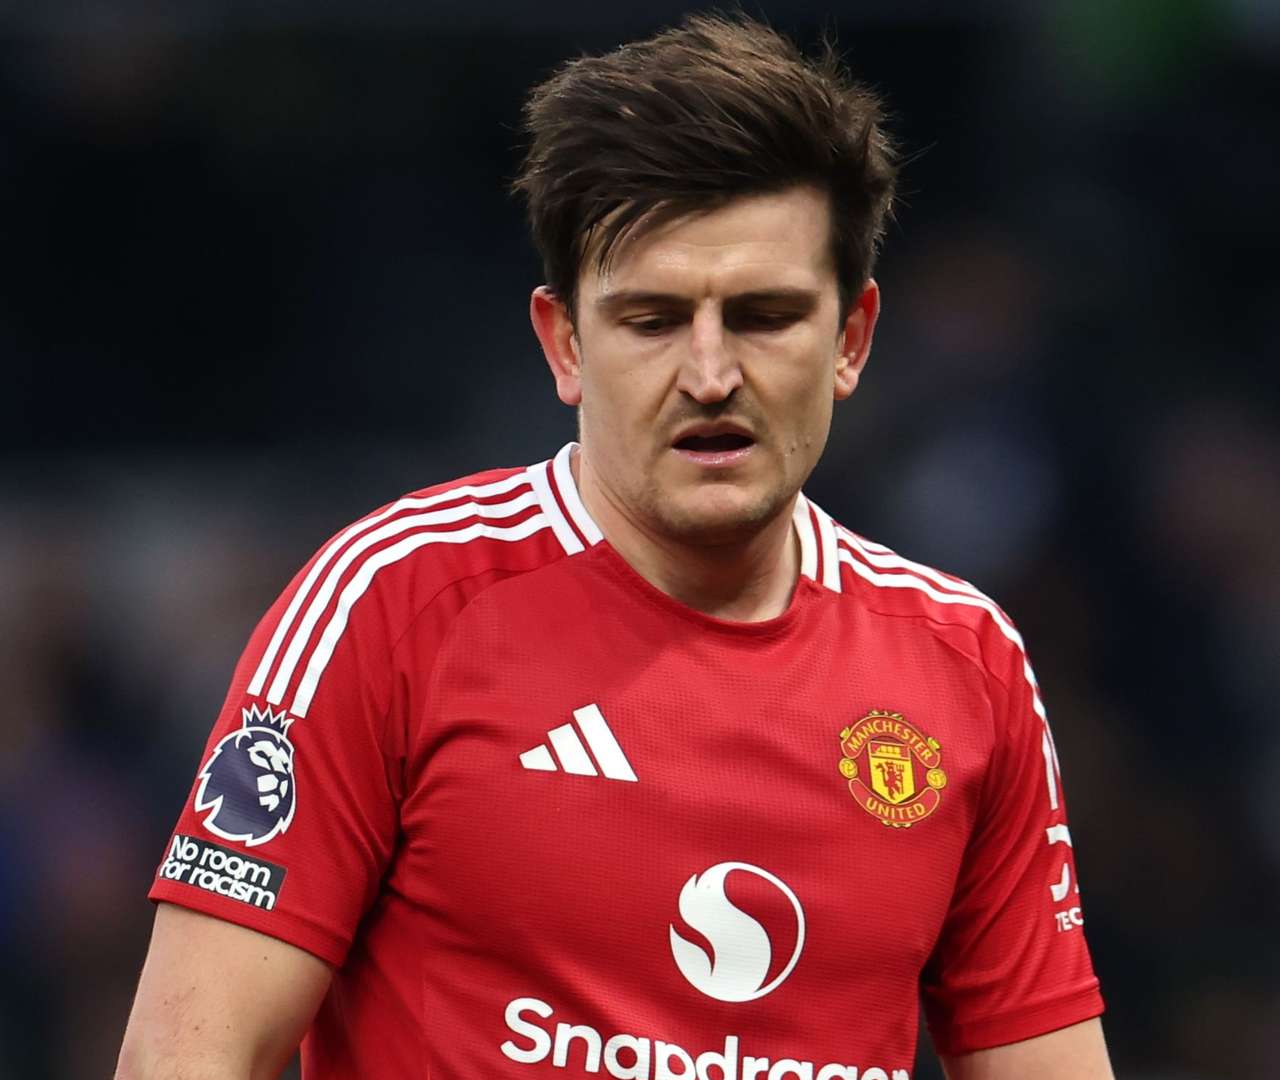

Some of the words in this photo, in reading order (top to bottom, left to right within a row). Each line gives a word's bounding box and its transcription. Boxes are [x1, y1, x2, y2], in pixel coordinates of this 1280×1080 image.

[847, 720, 933, 760] MANCHESTER
[866, 797, 925, 819] UNITED
[160, 857, 190, 881] for
[189, 864, 276, 910] racism
[168, 835, 199, 861] No
[201, 846, 270, 887] room
